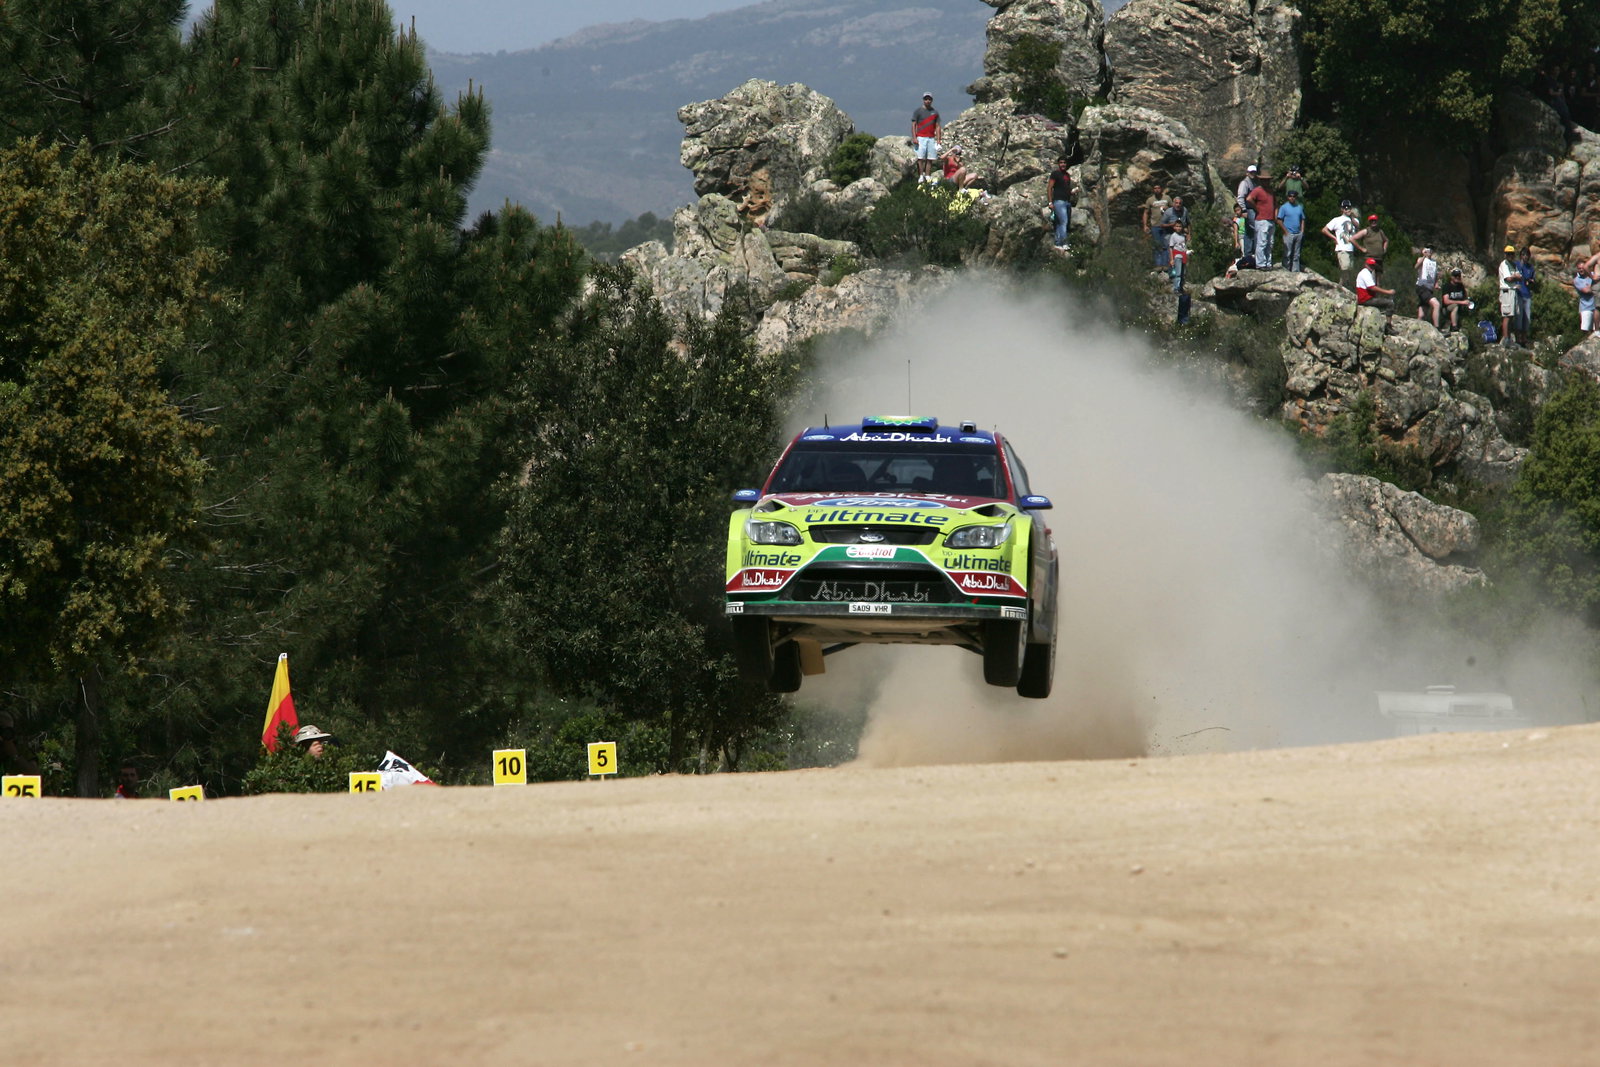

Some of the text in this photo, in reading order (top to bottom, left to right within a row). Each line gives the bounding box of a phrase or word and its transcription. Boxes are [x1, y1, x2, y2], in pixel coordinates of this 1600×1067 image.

[840, 432, 882, 442] Abu
[884, 432, 952, 443] Dhabi
[836, 499, 919, 507] Ford
[805, 510, 949, 525] ultimate
[742, 550, 802, 566] ultimate
[858, 546, 893, 557] Cstrol
[944, 554, 1012, 572] ultimate
[755, 572, 784, 586] Dhabi
[961, 574, 1010, 590] Abu Dhab
[811, 581, 930, 602] Abu Dhabi
[852, 604, 870, 612] SA09
[597, 750, 607, 767] 5
[498, 757, 521, 776] 10
[7, 784, 34, 798] 25
[354, 780, 376, 792] 15
